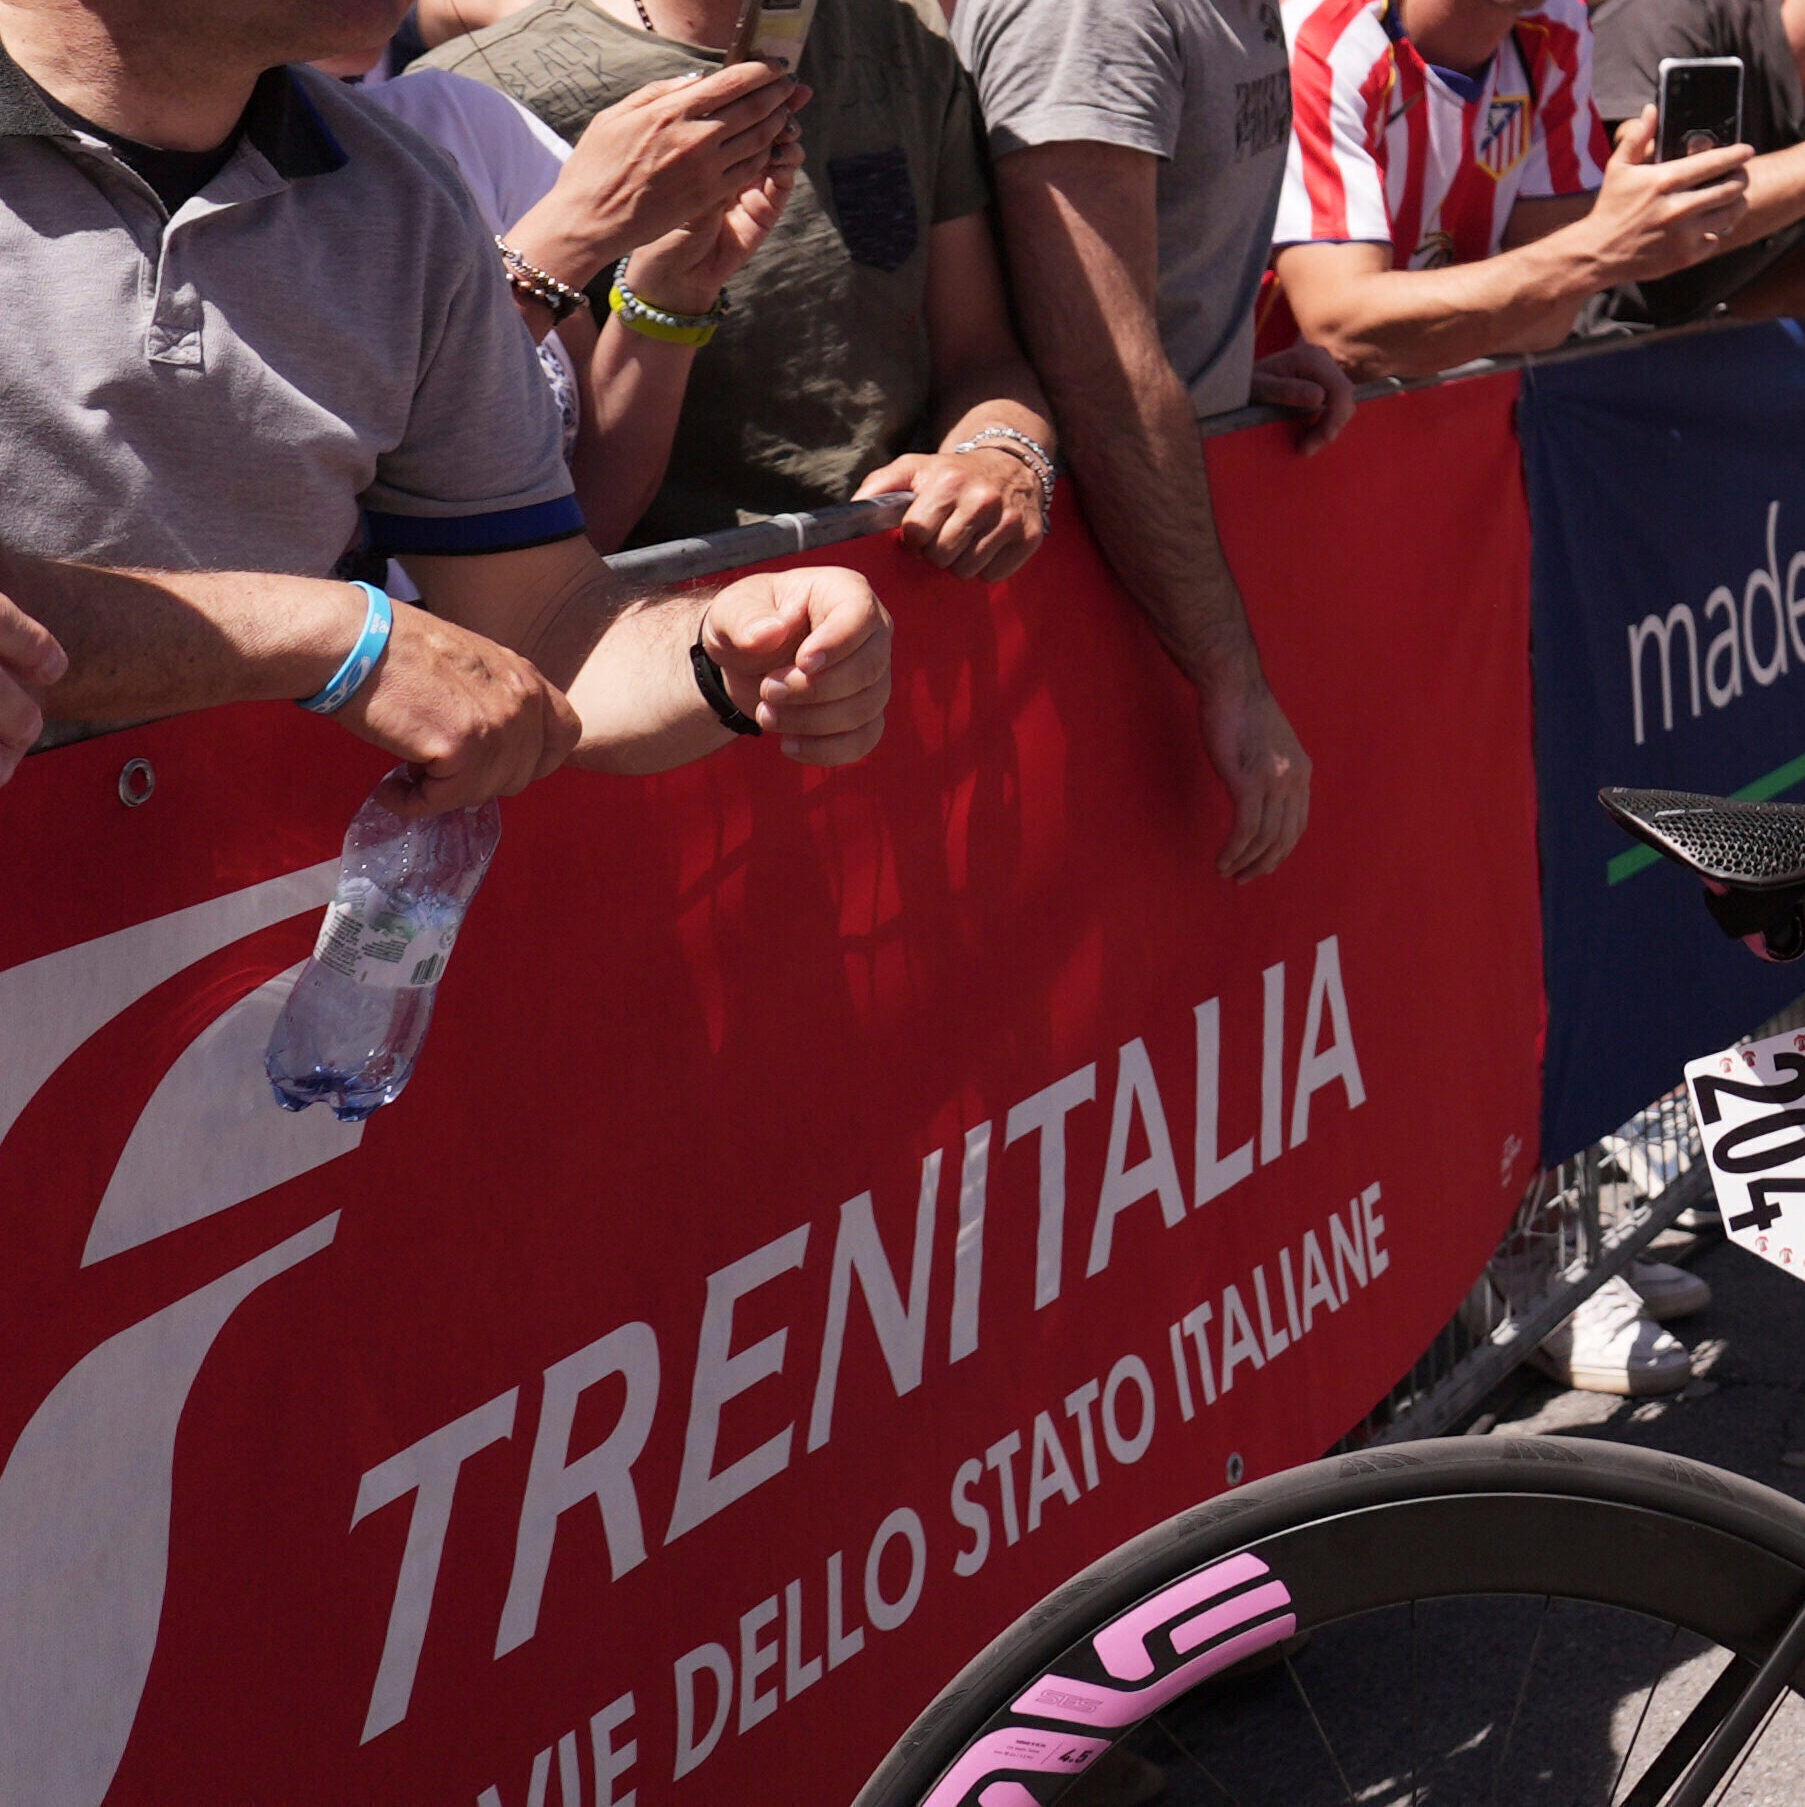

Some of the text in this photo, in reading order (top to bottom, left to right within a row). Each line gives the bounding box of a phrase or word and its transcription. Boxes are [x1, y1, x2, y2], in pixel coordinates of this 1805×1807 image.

[348, 934, 1369, 1745] TRENITALIA
[672, 1505, 928, 1781] DELLO
[951, 1353, 1156, 1578] STATO
[1167, 1180, 1392, 1423] ITALIANE
